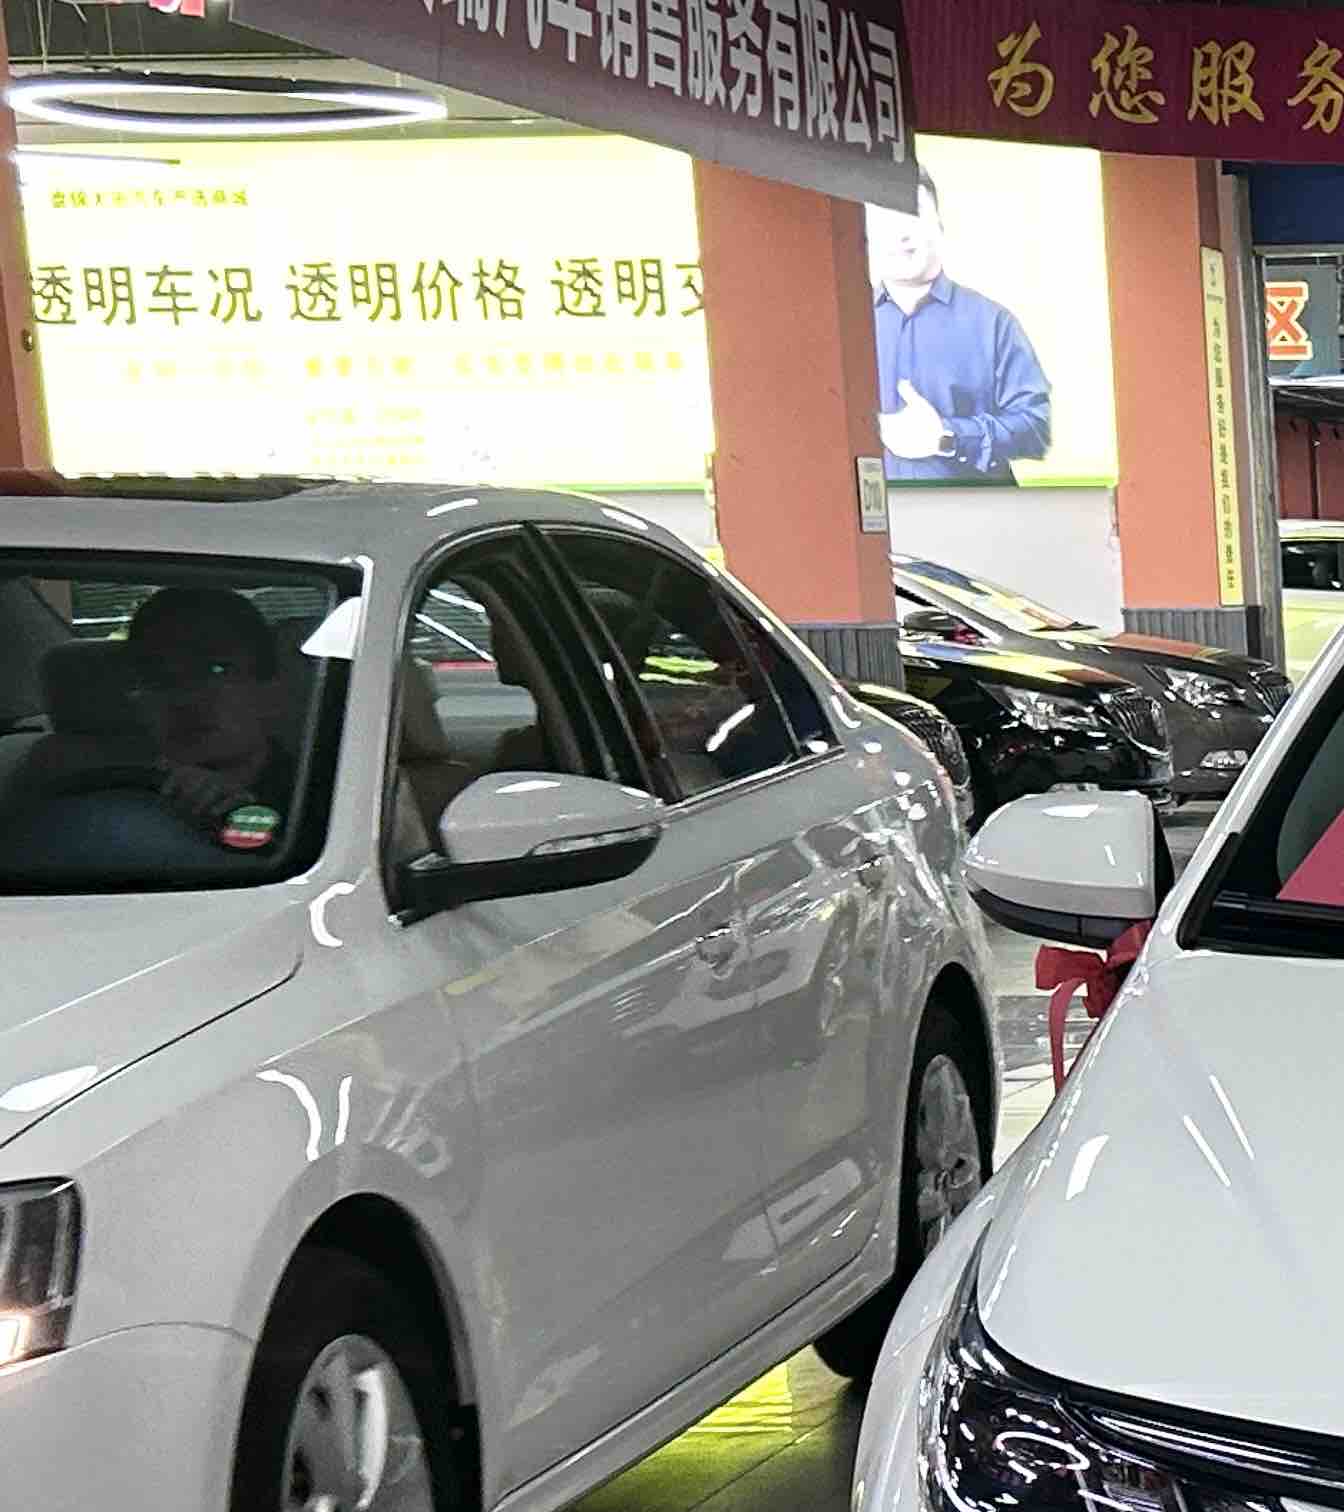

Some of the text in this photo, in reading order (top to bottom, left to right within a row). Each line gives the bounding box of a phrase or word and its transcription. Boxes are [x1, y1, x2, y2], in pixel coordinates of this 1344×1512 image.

[32, 264, 263, 326] 透明车况
[284, 257, 526, 323] 透明价格
